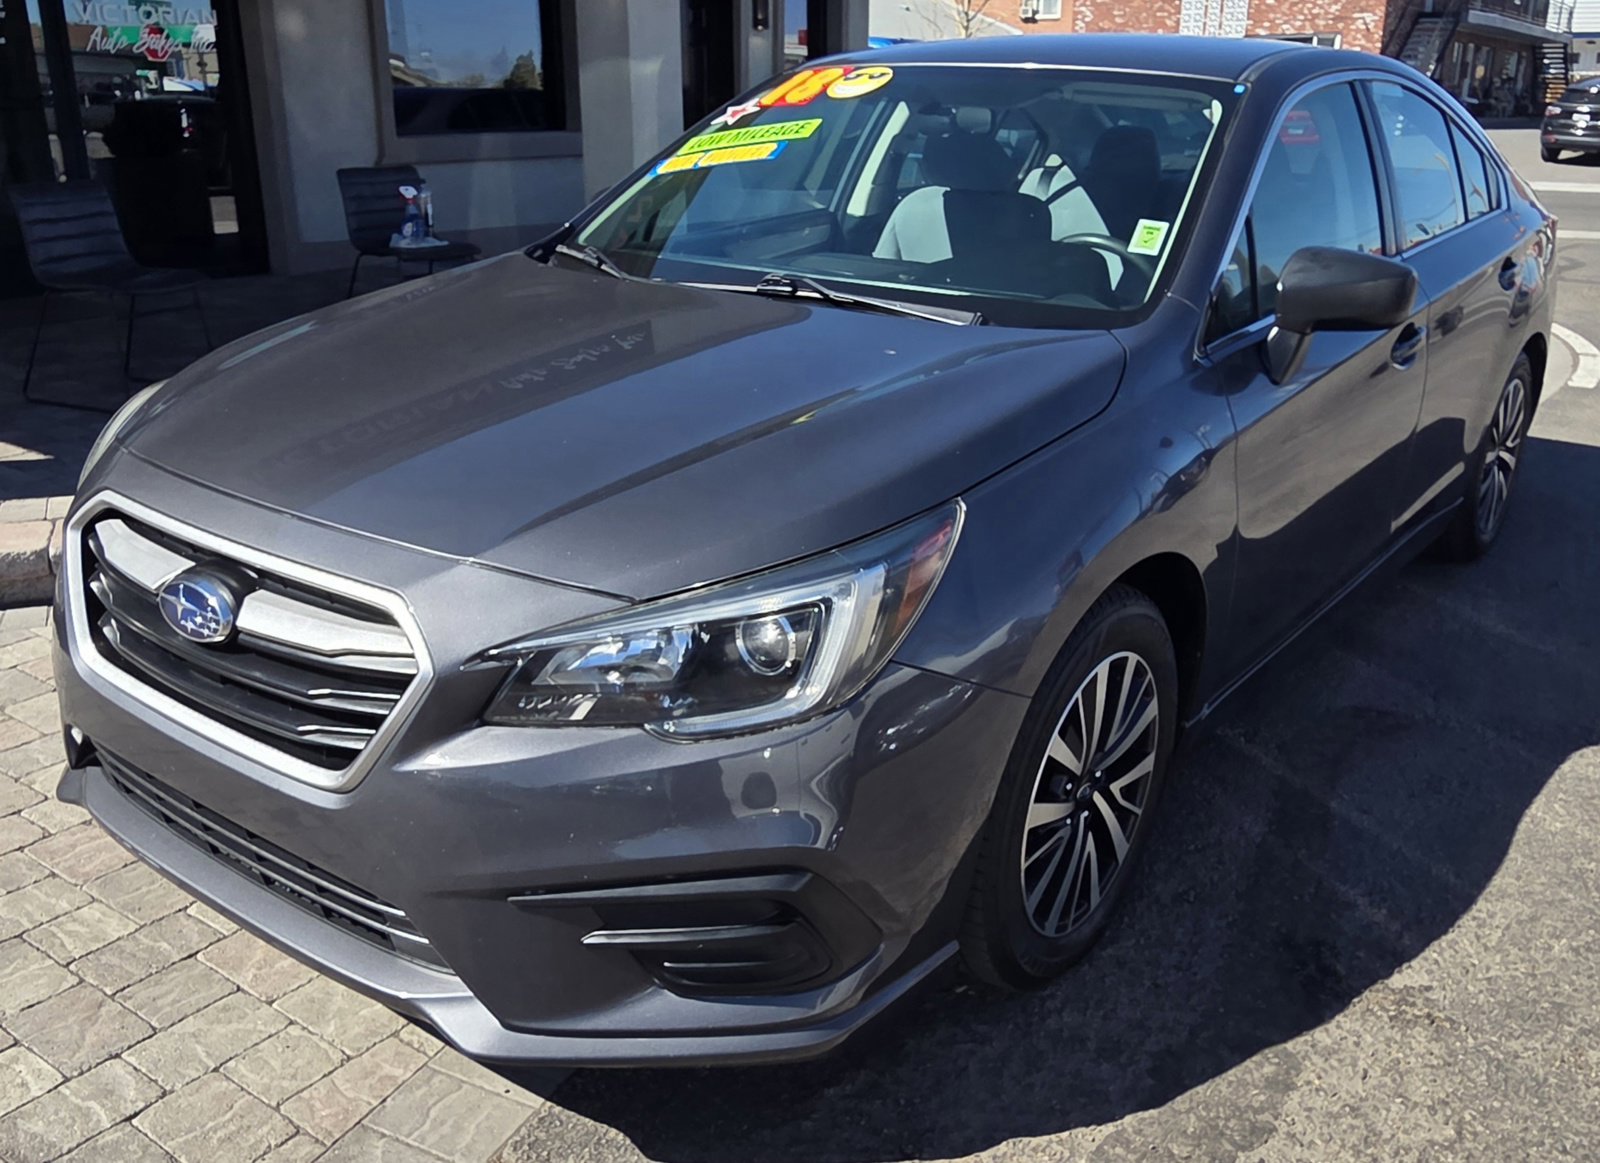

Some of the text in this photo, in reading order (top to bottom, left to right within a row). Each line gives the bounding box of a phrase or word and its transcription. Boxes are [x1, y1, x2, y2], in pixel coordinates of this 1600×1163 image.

[72, 3, 218, 27] VICTORIAN
[86, 26, 128, 54] Auto
[132, 25, 182, 57] Sales
[688, 121, 812, 151] LOW MILEAGE
